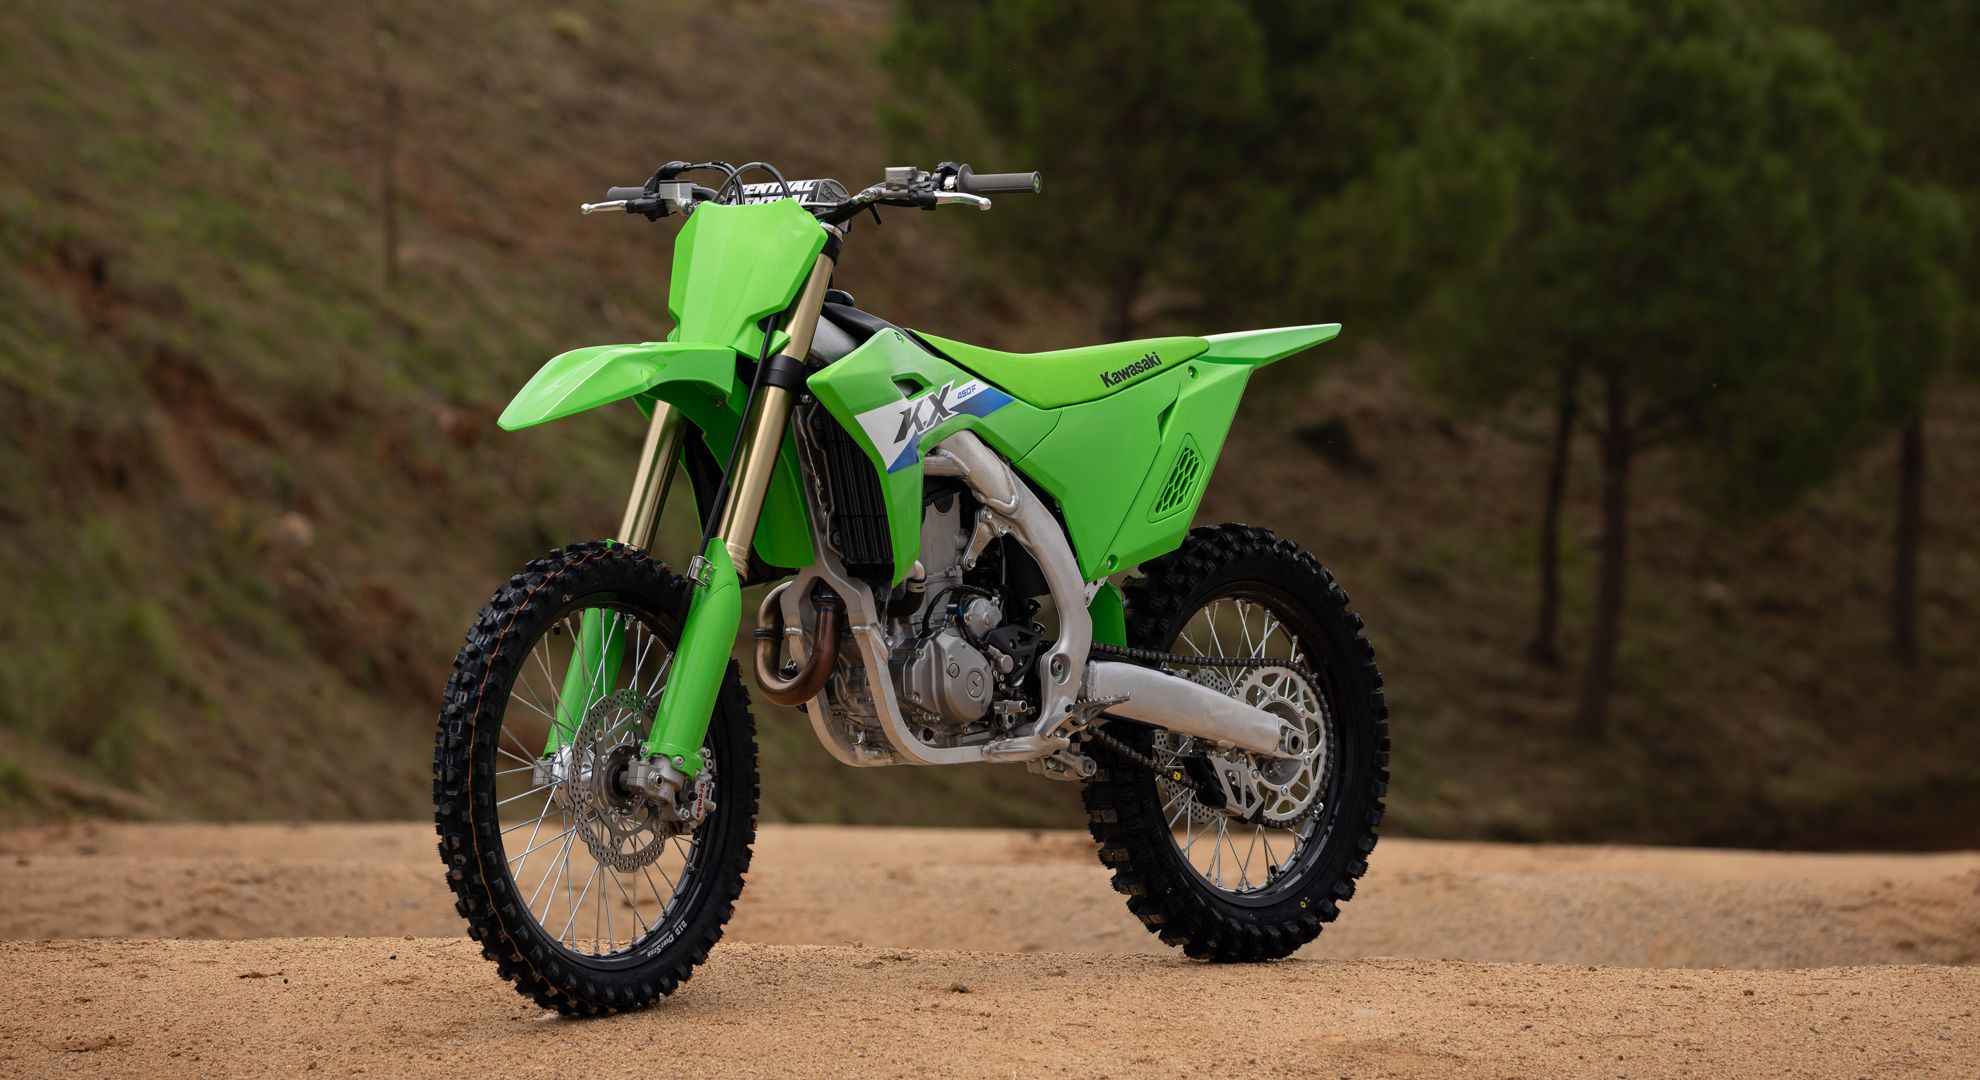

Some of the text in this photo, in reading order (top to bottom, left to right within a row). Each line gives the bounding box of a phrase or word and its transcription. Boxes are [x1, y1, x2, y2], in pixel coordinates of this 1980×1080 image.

[731, 180, 815, 195] ENTHAL
[1100, 351, 1162, 388] Kawasaki
[893, 384, 953, 444] KX
[695, 782, 706, 819] brembo
